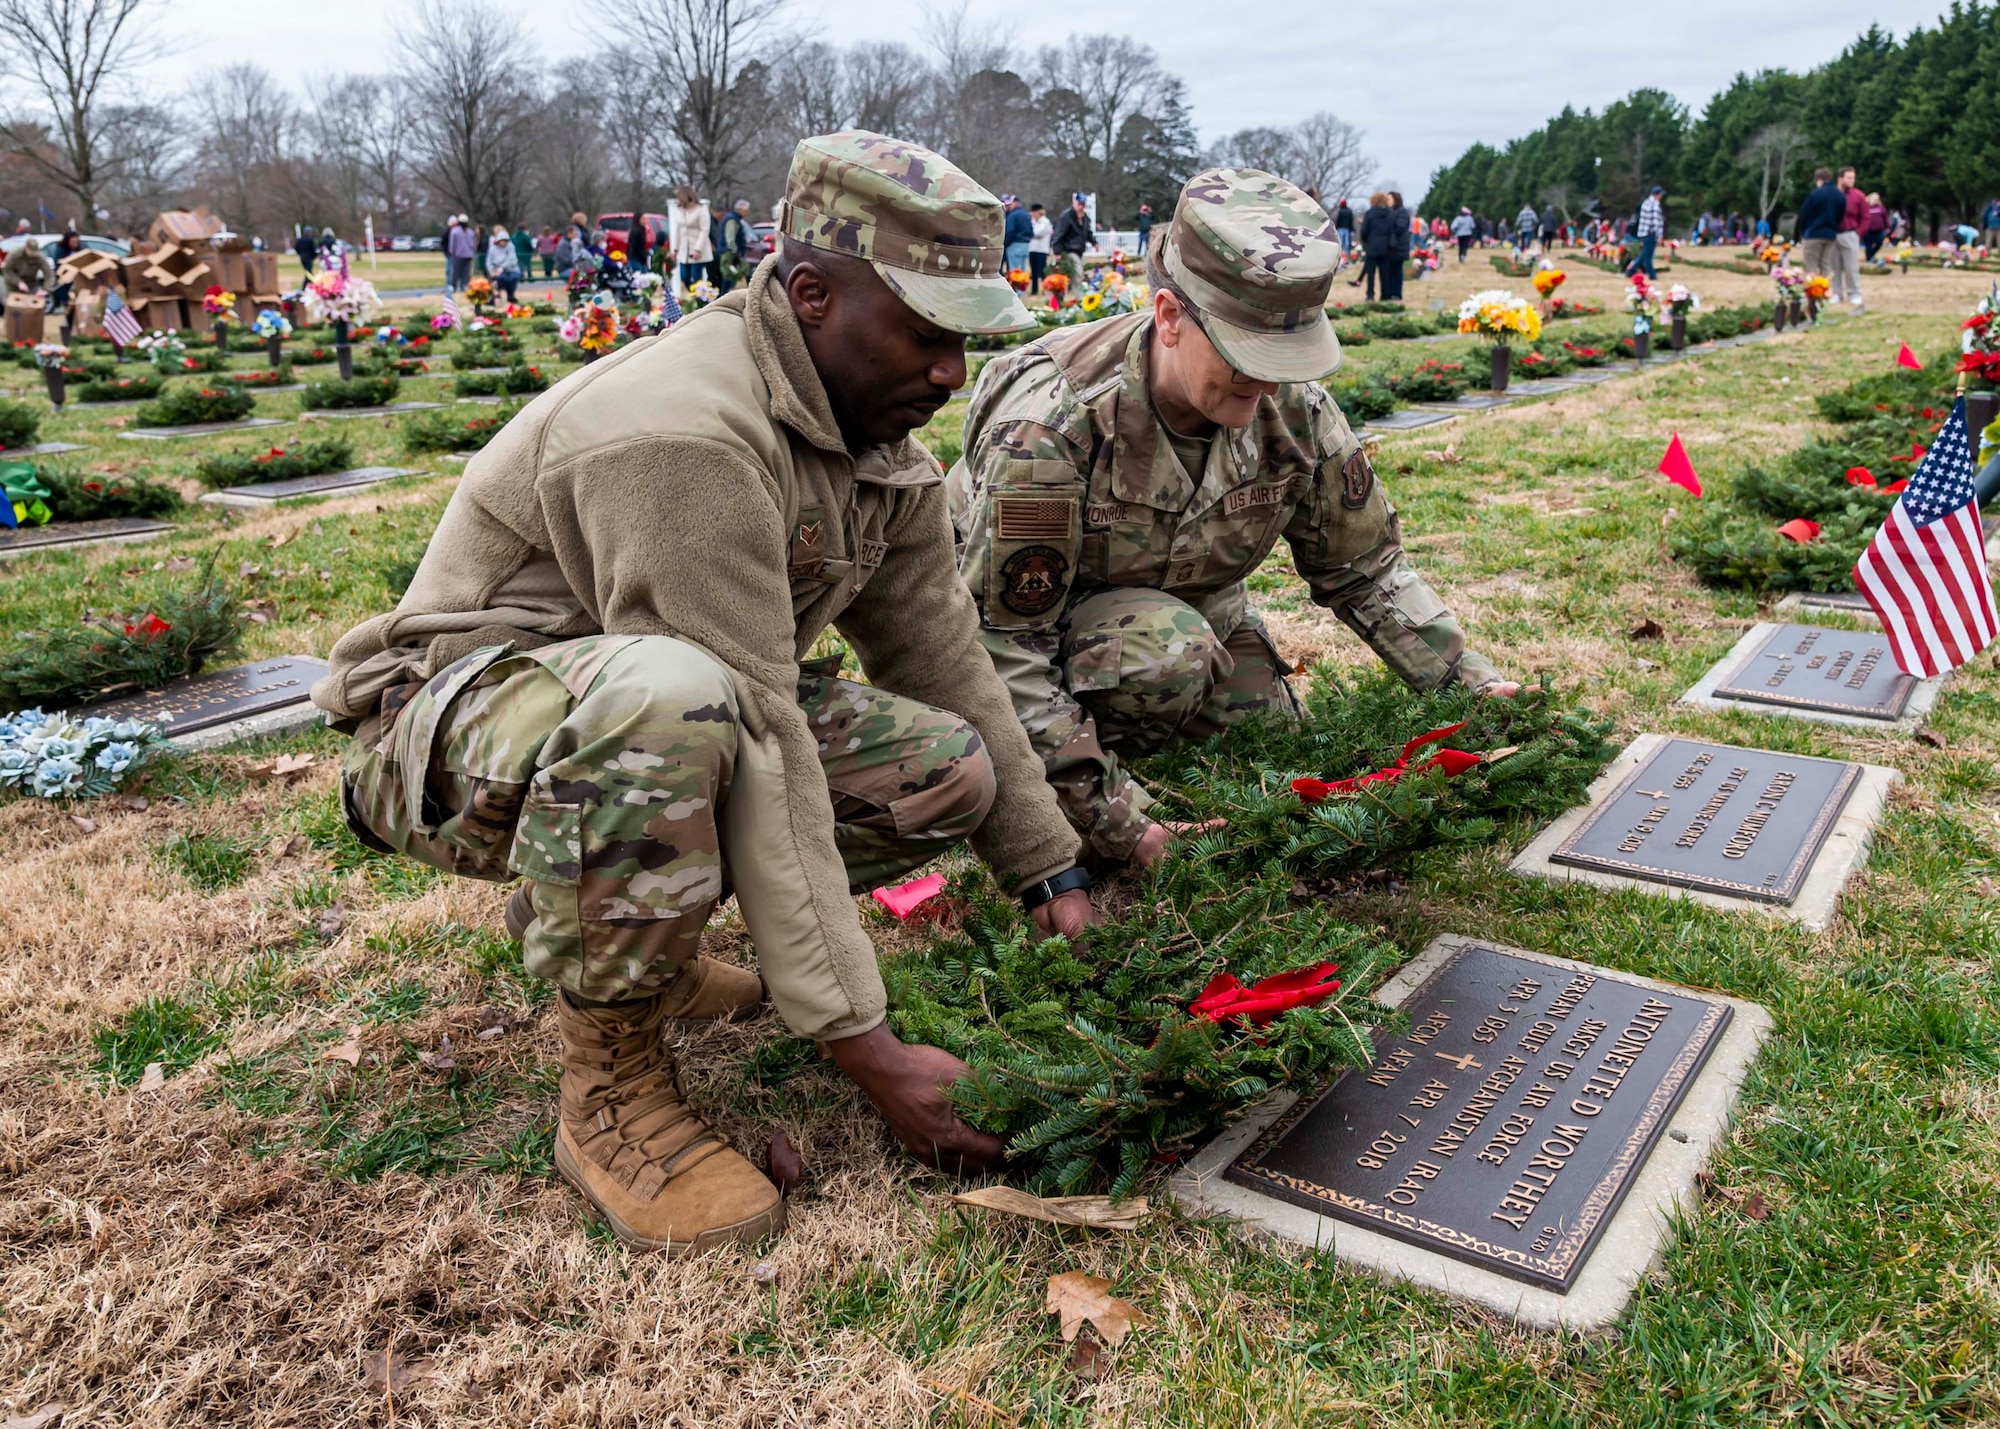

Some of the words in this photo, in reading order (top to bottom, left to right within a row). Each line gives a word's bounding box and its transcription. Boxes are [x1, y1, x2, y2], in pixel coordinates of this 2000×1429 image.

[1229, 493, 1246, 510] US
[1249, 486, 1270, 504] AIR
[1083, 504, 1129, 522] MONROE
[862, 543, 883, 564] RCE
[1719, 782, 1738, 791] US
[1761, 771, 1796, 800] FARON
[1642, 806, 1670, 822] MAR
[1695, 792, 1730, 819] MARINE
[1755, 801, 1776, 809] C
[1633, 823, 1655, 833] 19
[1675, 820, 1708, 847] CORPS
[1722, 810, 1770, 859] MUMFORD
[1617, 834, 1646, 853] 2018
[1508, 977, 1542, 1002] APR
[1545, 973, 1598, 1018] PERSIAN
[1498, 1004, 1519, 1014] 3
[1407, 1010, 1452, 1045] AFCM
[1472, 1015, 1508, 1043] 1963
[1518, 1020, 1557, 1053] GULF
[1566, 1017, 1607, 1059] SMSGT
[1582, 997, 1673, 1099] ANTOINETTE
[1367, 1048, 1416, 1088] AFAM
[1543, 1061, 1575, 1080] US
[1409, 1079, 1450, 1109] APR
[1428, 1055, 1528, 1157] AFGHANISTAN
[1519, 1082, 1557, 1110] AIR
[1570, 1099, 1602, 1117] D
[1397, 1113, 1421, 1127] 7
[1357, 1130, 1407, 1169] 2018
[1479, 1112, 1534, 1166] FORCE
[1384, 1160, 1442, 1206] IRAQ
[1491, 1123, 1588, 1230] WORTHEY
